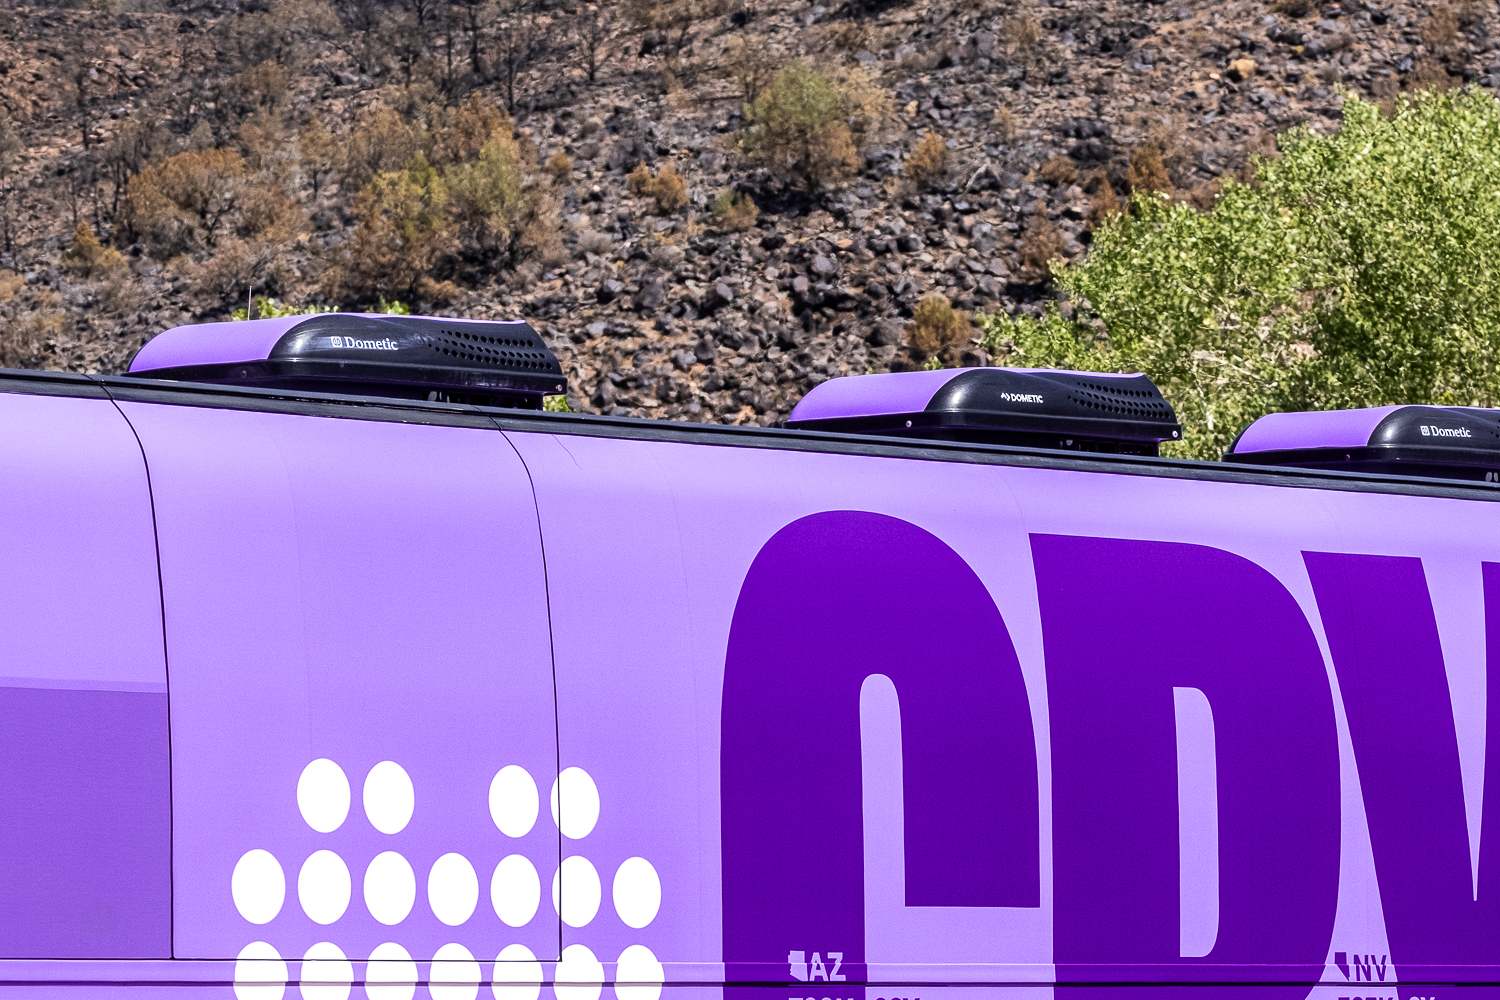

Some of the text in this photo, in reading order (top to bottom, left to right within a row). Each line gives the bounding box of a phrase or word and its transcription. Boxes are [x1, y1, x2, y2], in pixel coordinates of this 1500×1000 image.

[344, 336, 399, 351] Dometic
[1010, 393, 1044, 404] DOMETIC
[1430, 425, 1472, 438] Dometic
[809, 952, 847, 982] AZ
[1353, 954, 1387, 982] NV
